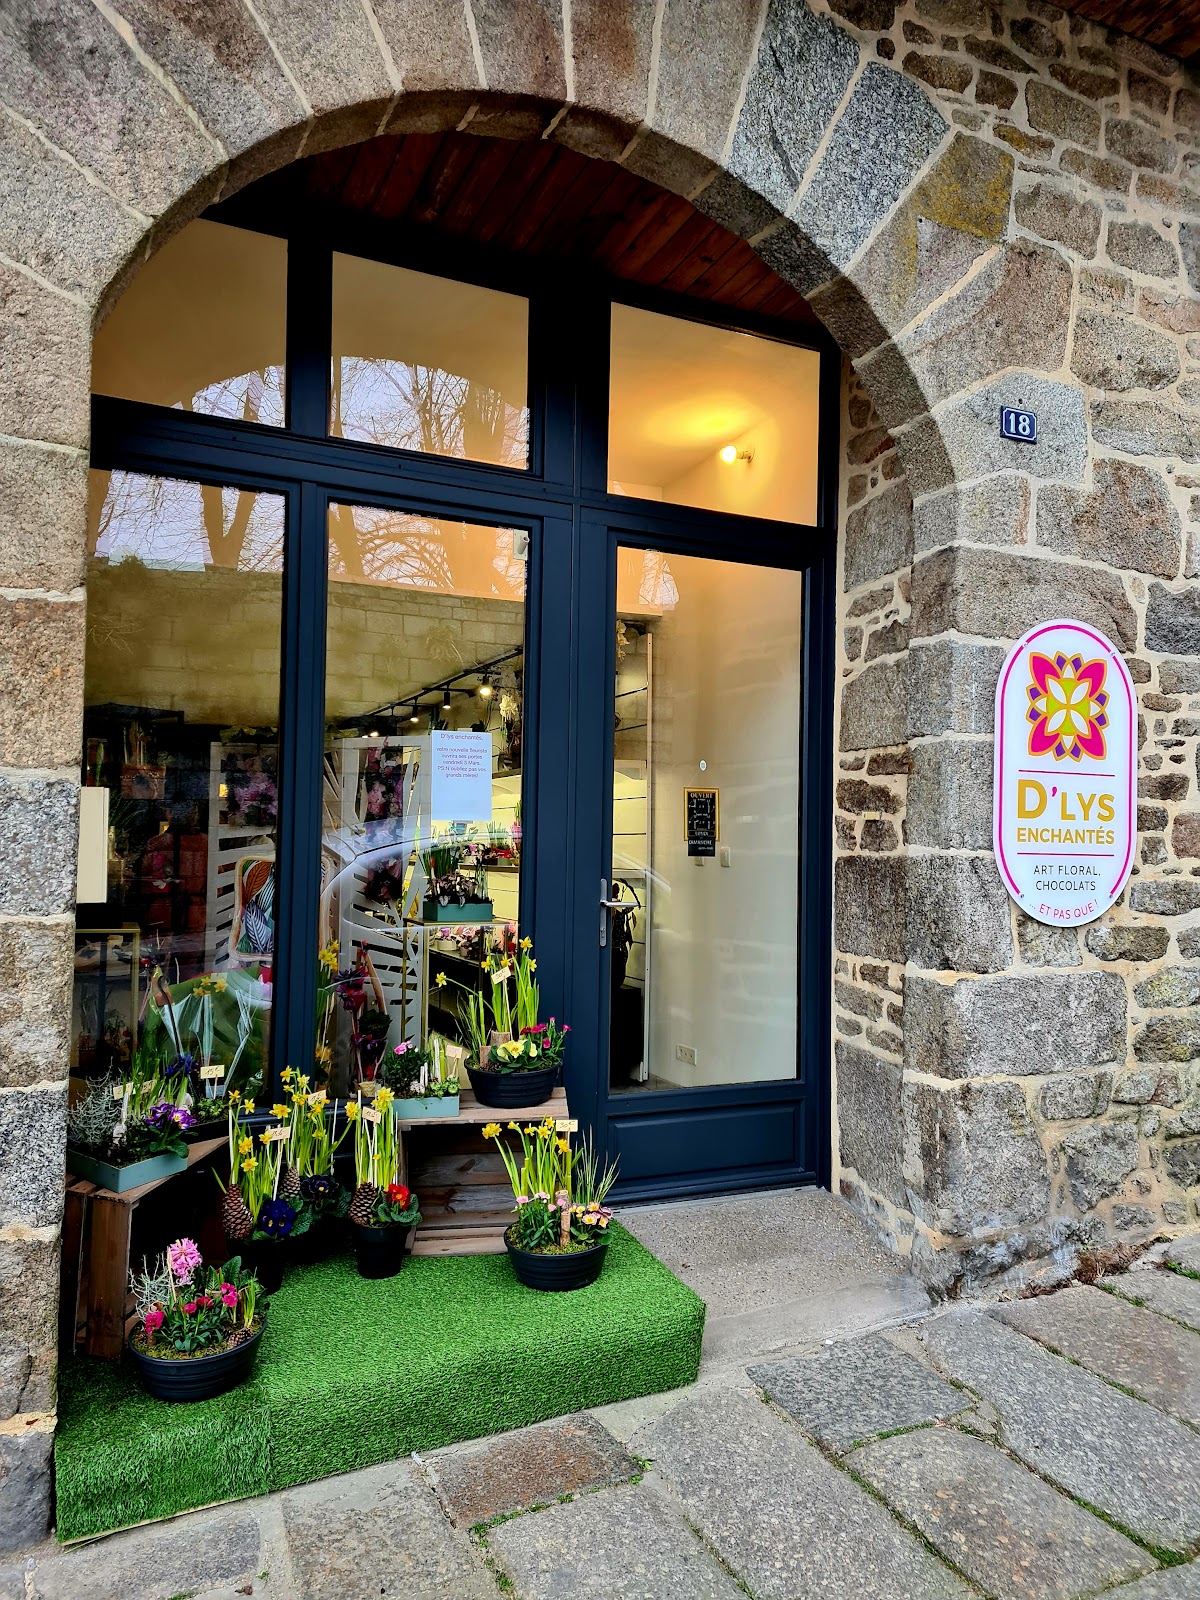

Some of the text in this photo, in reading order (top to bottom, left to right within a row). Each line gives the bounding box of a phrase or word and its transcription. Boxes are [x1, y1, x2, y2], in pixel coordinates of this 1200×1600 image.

[1009, 412, 1031, 436] 18
[1017, 779, 1115, 822] D'LYS
[1016, 826, 1115, 845] ENCHANTÉS
[1033, 864, 1054, 875] ART
[1035, 880, 1096, 891] CHOCOLATS
[1039, 903, 1051, 916] ET
[1053, 908, 1071, 920] PAS
[1074, 903, 1095, 918] QUE
